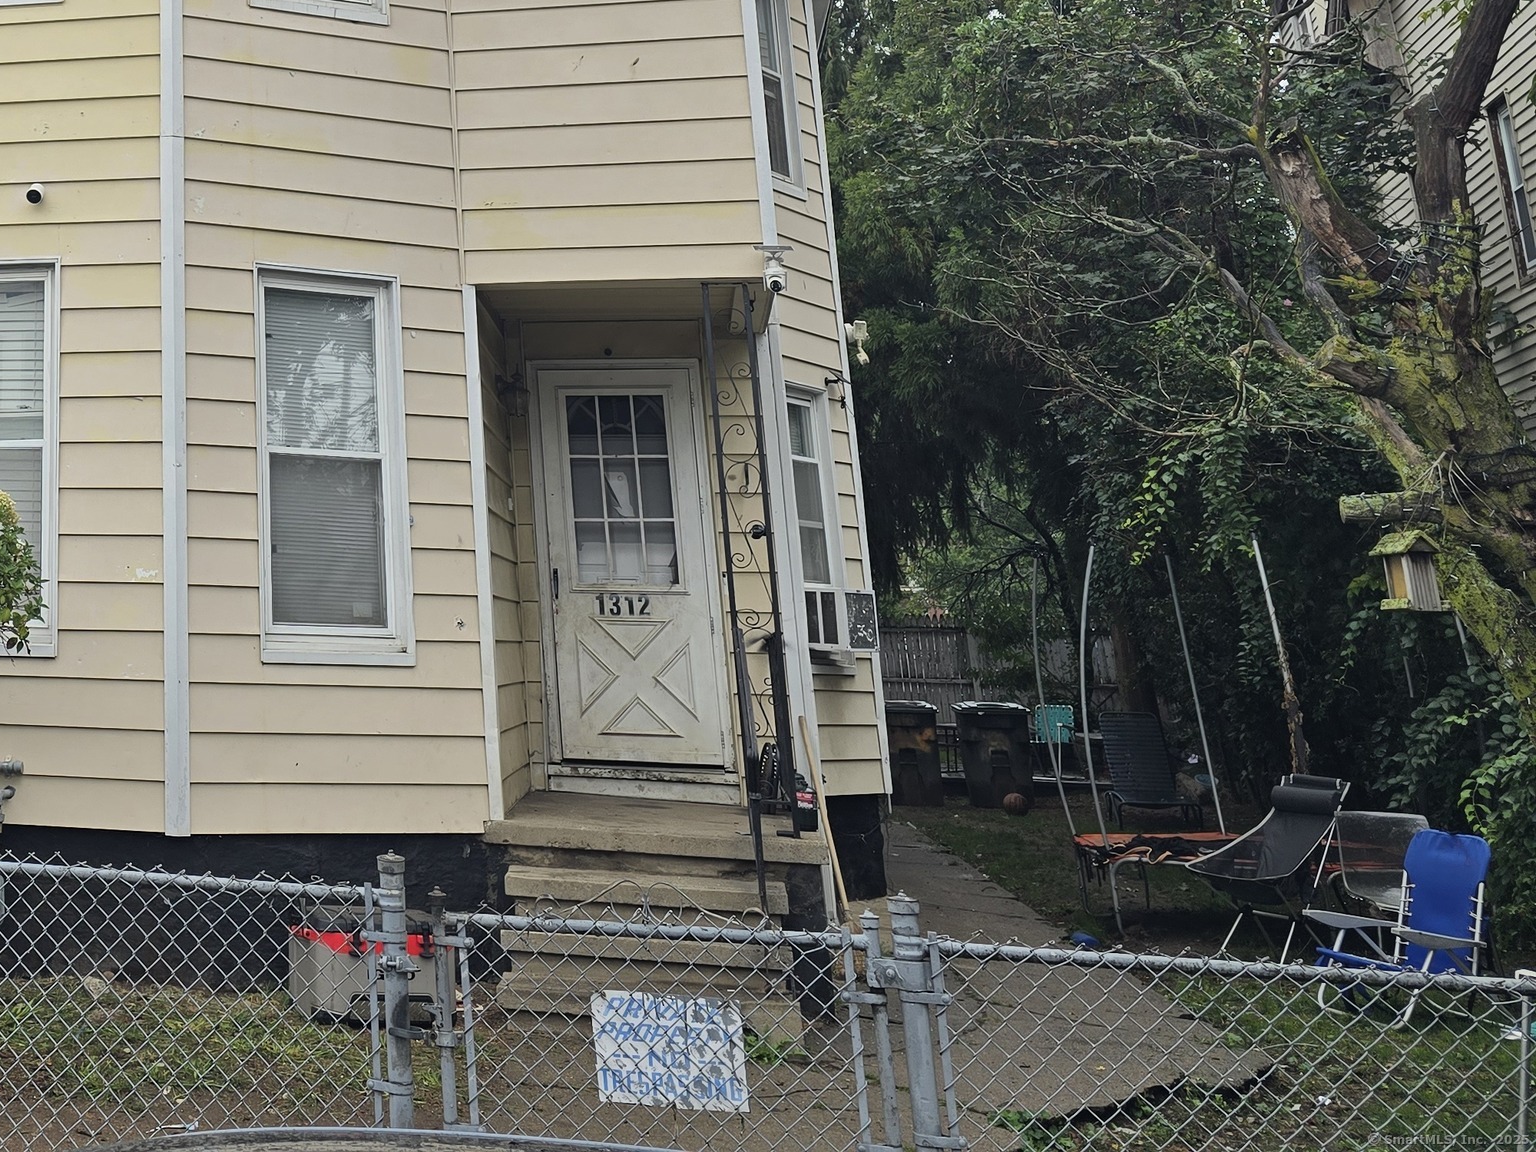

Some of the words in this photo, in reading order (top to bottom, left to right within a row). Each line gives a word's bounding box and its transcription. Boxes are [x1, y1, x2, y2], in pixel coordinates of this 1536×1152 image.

[595, 593, 651, 616] 1312
[603, 997, 722, 1024] PRIVA
[598, 1021, 739, 1046] PROPER
[649, 1050, 691, 1070] NO
